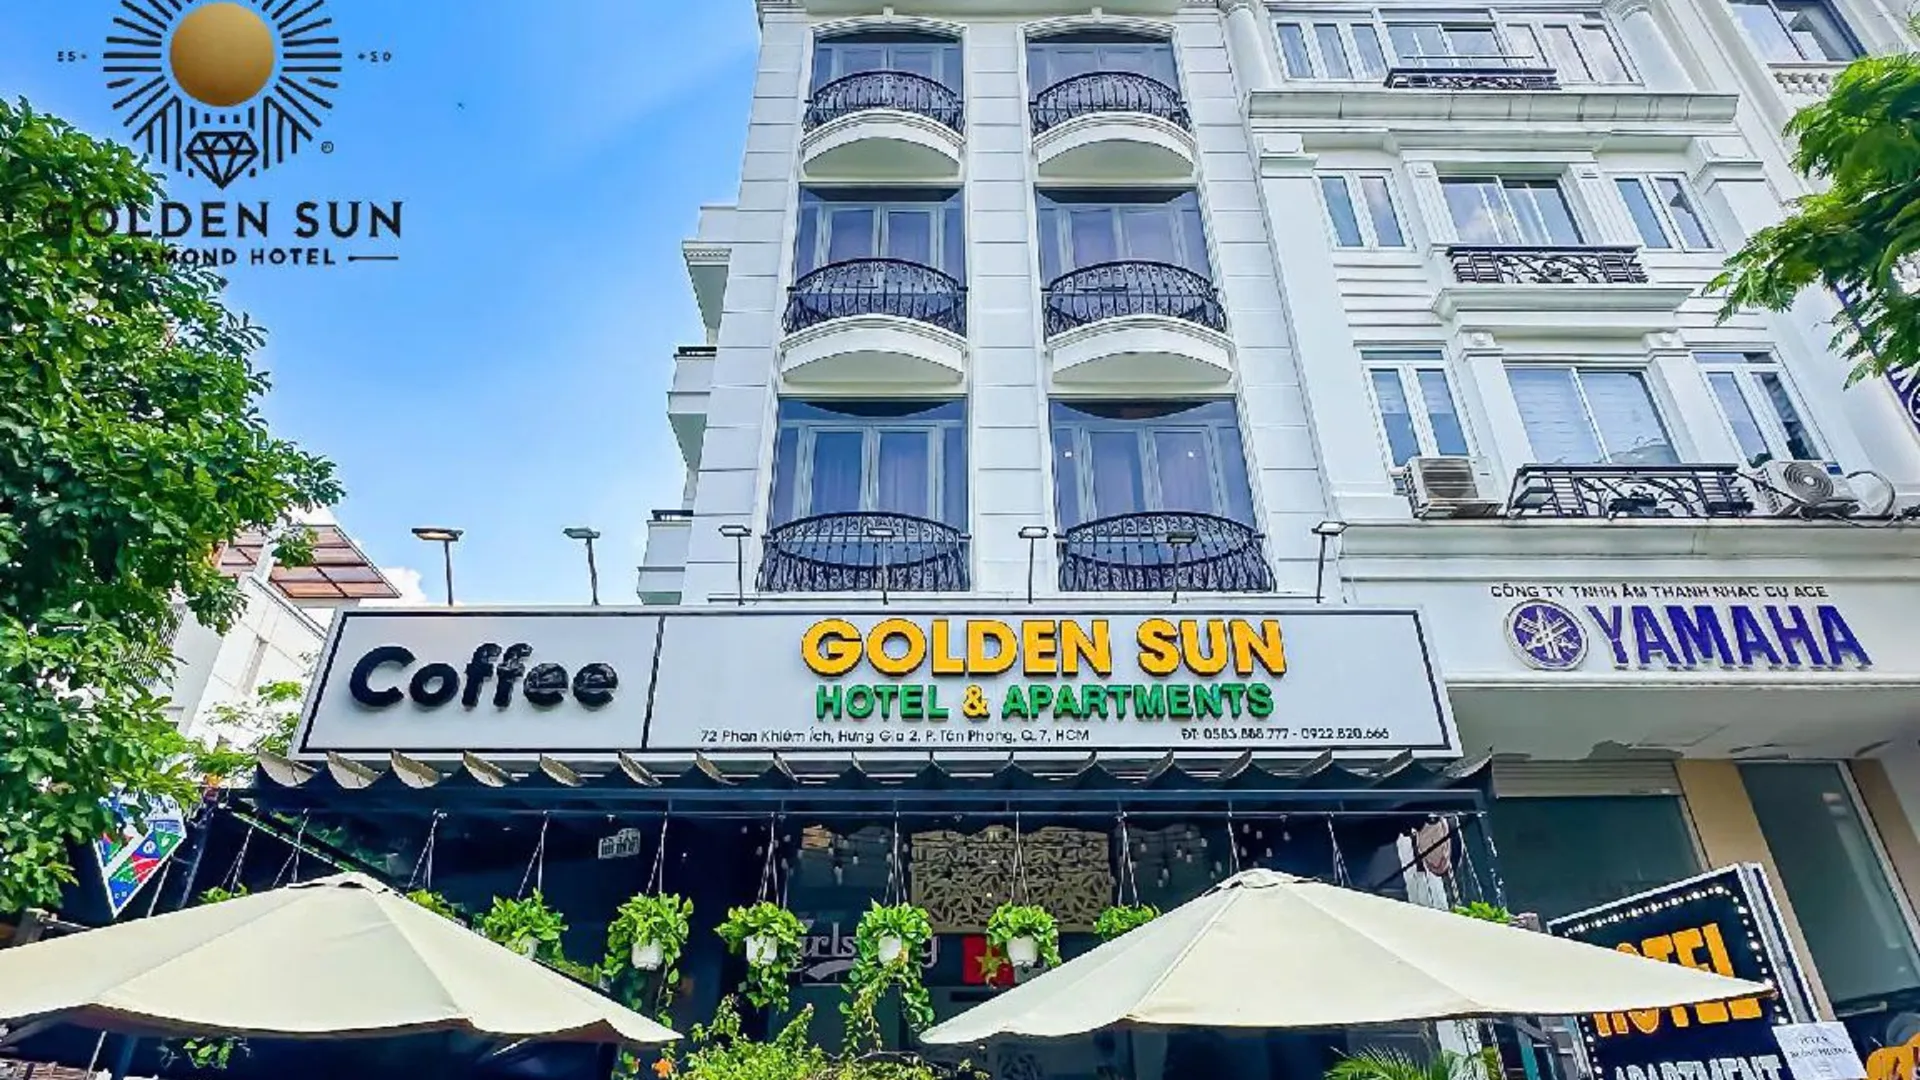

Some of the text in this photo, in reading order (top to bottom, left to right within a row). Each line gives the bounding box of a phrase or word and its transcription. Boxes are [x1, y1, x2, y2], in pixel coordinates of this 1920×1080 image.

[1490, 583, 1540, 598] CÔNG
[1542, 586, 1564, 598] TY
[1569, 586, 1618, 598] TNHH
[1650, 586, 1710, 598] THANH
[1794, 586, 1829, 598] ACE
[801, 617, 1287, 676] GOLDEN SUN
[1585, 605, 1872, 669] YAMAHA
[349, 642, 618, 708] Coffee
[816, 684, 1275, 720] HOTEL & APARTMENTS
[701, 730, 718, 743] 72
[722, 730, 757, 742] Phan
[879, 730, 905, 742] Gia
[926, 730, 936, 742] P.
[1056, 730, 1089, 742] HCM
